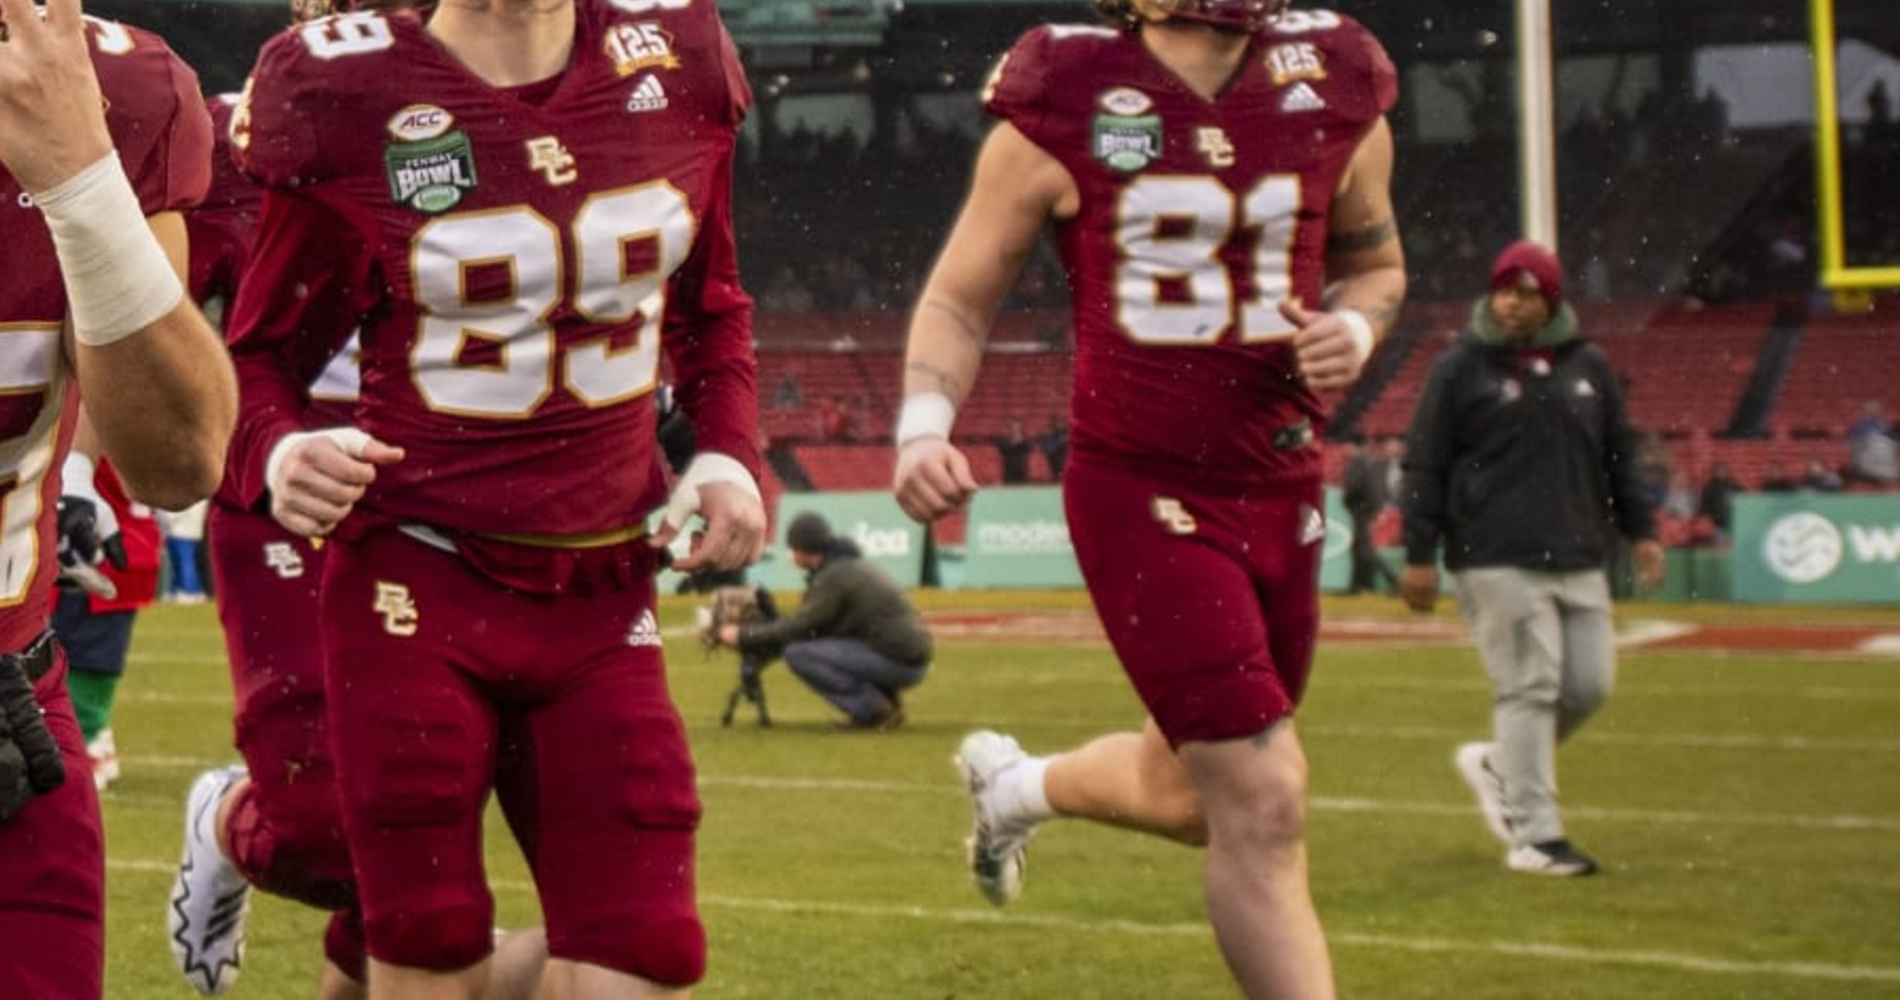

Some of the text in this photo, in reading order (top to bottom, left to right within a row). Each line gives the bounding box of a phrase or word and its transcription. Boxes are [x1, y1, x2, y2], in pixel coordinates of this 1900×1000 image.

[606, 23, 671, 66] 125
[1268, 43, 1321, 75] 125
[401, 111, 442, 130] ACC
[396, 159, 471, 201] BOWL
[1116, 173, 1304, 346] 81
[409, 177, 697, 420] 89
